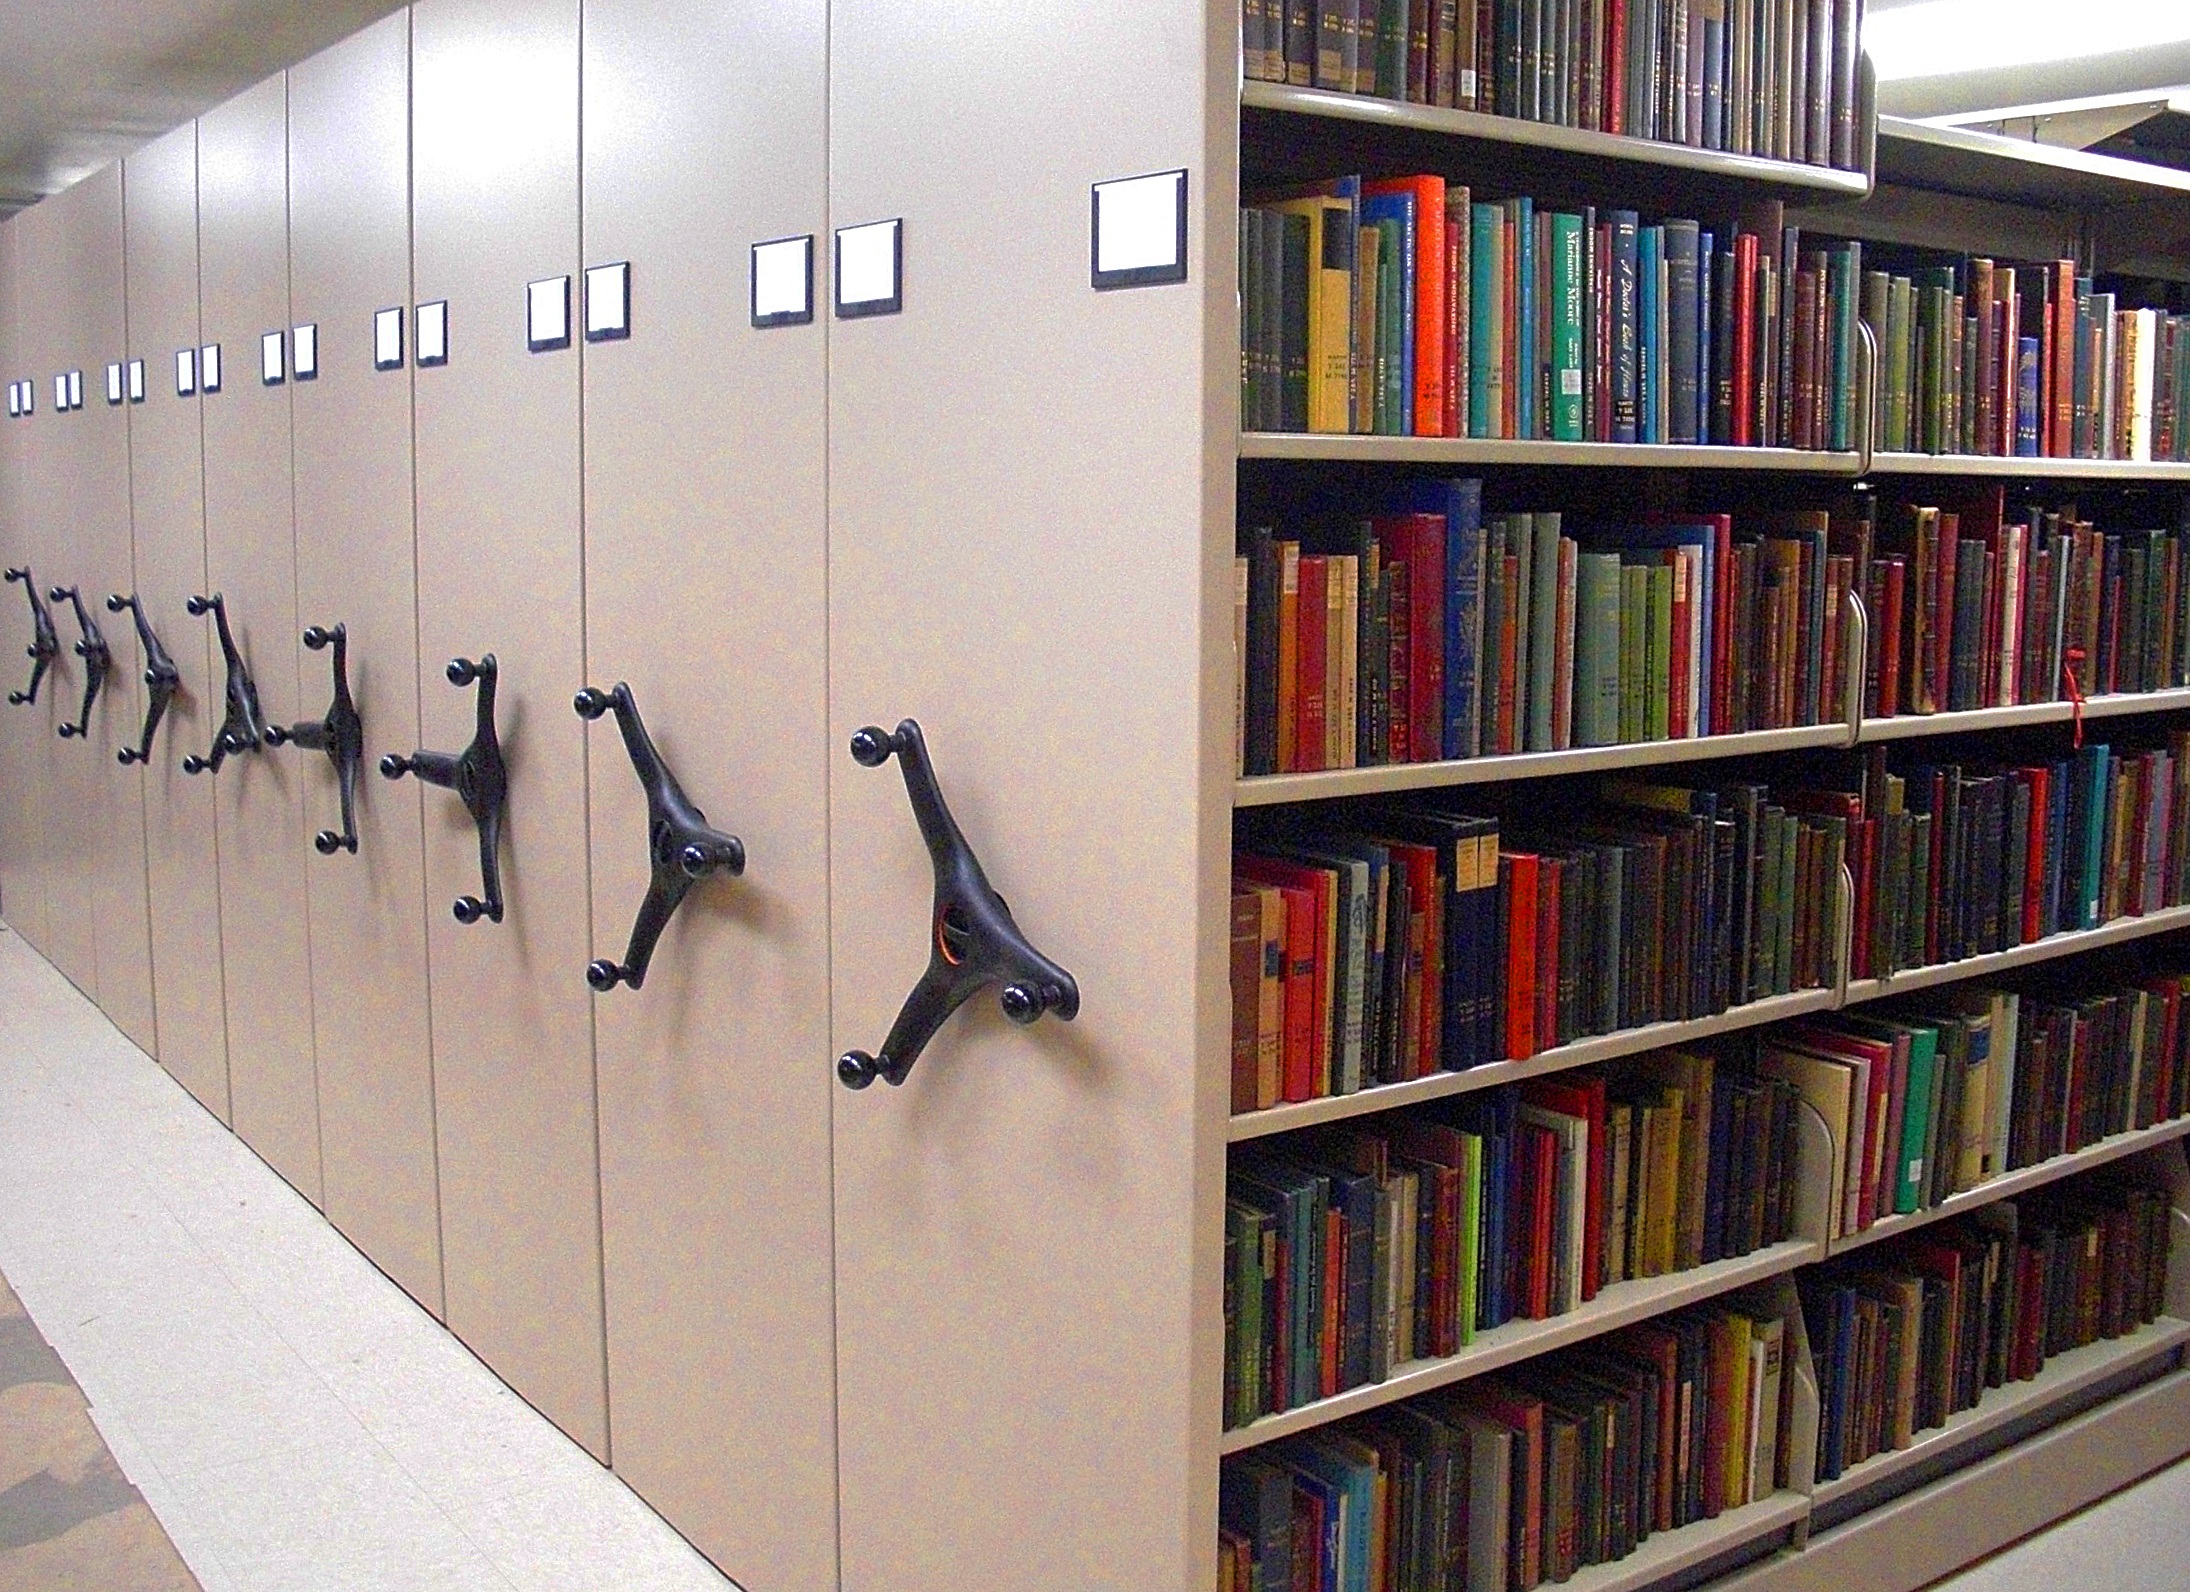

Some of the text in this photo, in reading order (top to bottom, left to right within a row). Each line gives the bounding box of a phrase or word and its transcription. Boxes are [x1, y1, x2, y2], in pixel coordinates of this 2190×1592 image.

[1567, 231, 1576, 326] Marianne Moore
[1621, 259, 1633, 276] A
[1621, 278, 1633, 318] Doctor's
[1621, 323, 1633, 350] Book
[1620, 353, 1632, 364] of
